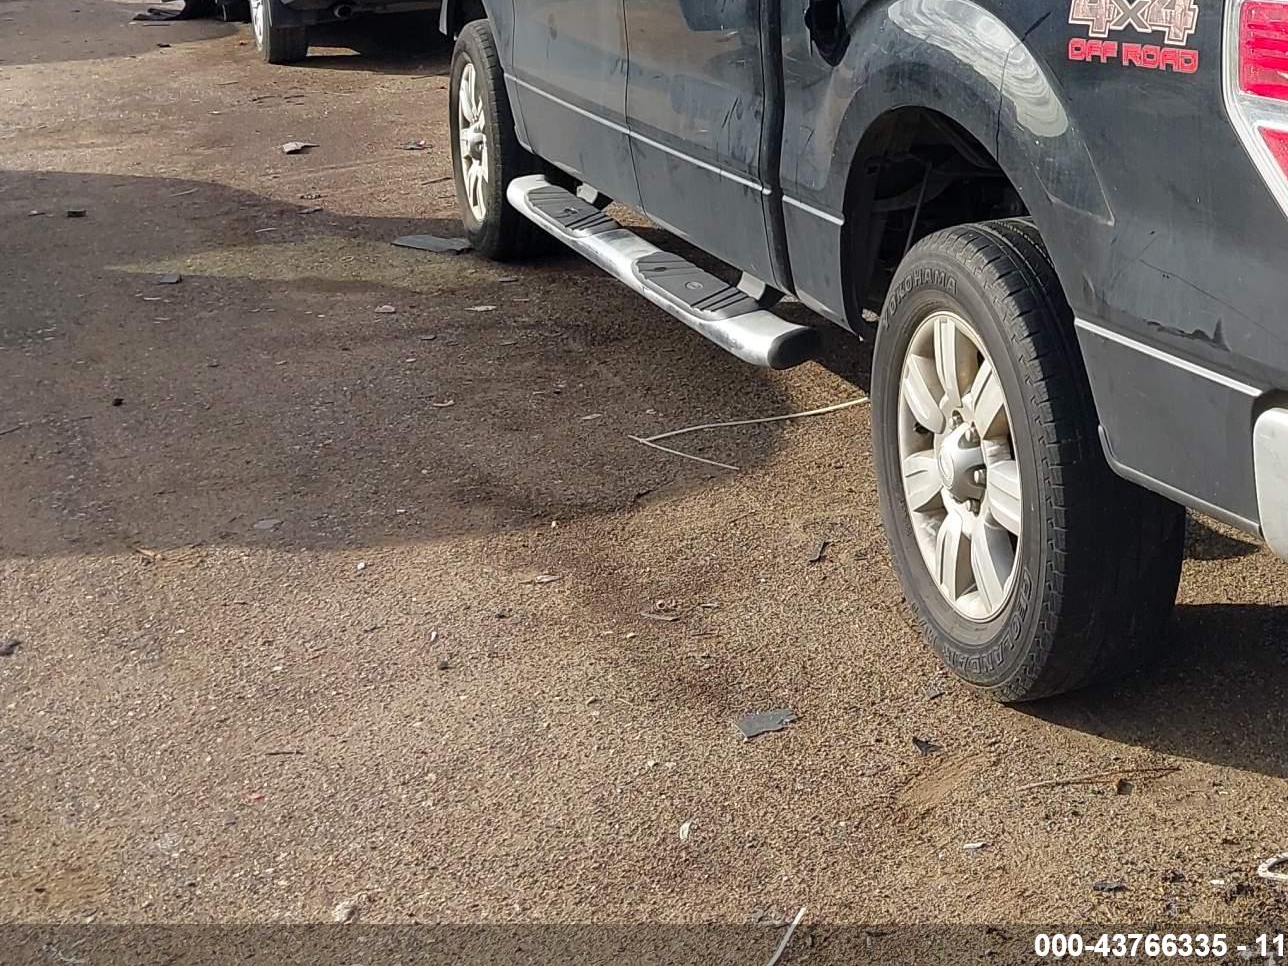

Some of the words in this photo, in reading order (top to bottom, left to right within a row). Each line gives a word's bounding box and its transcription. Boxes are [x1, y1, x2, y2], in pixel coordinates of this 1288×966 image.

[1068, 37, 1118, 63] OFF
[1122, 42, 1199, 74] ROAD
[882, 267, 957, 331] YOKOHAMA
